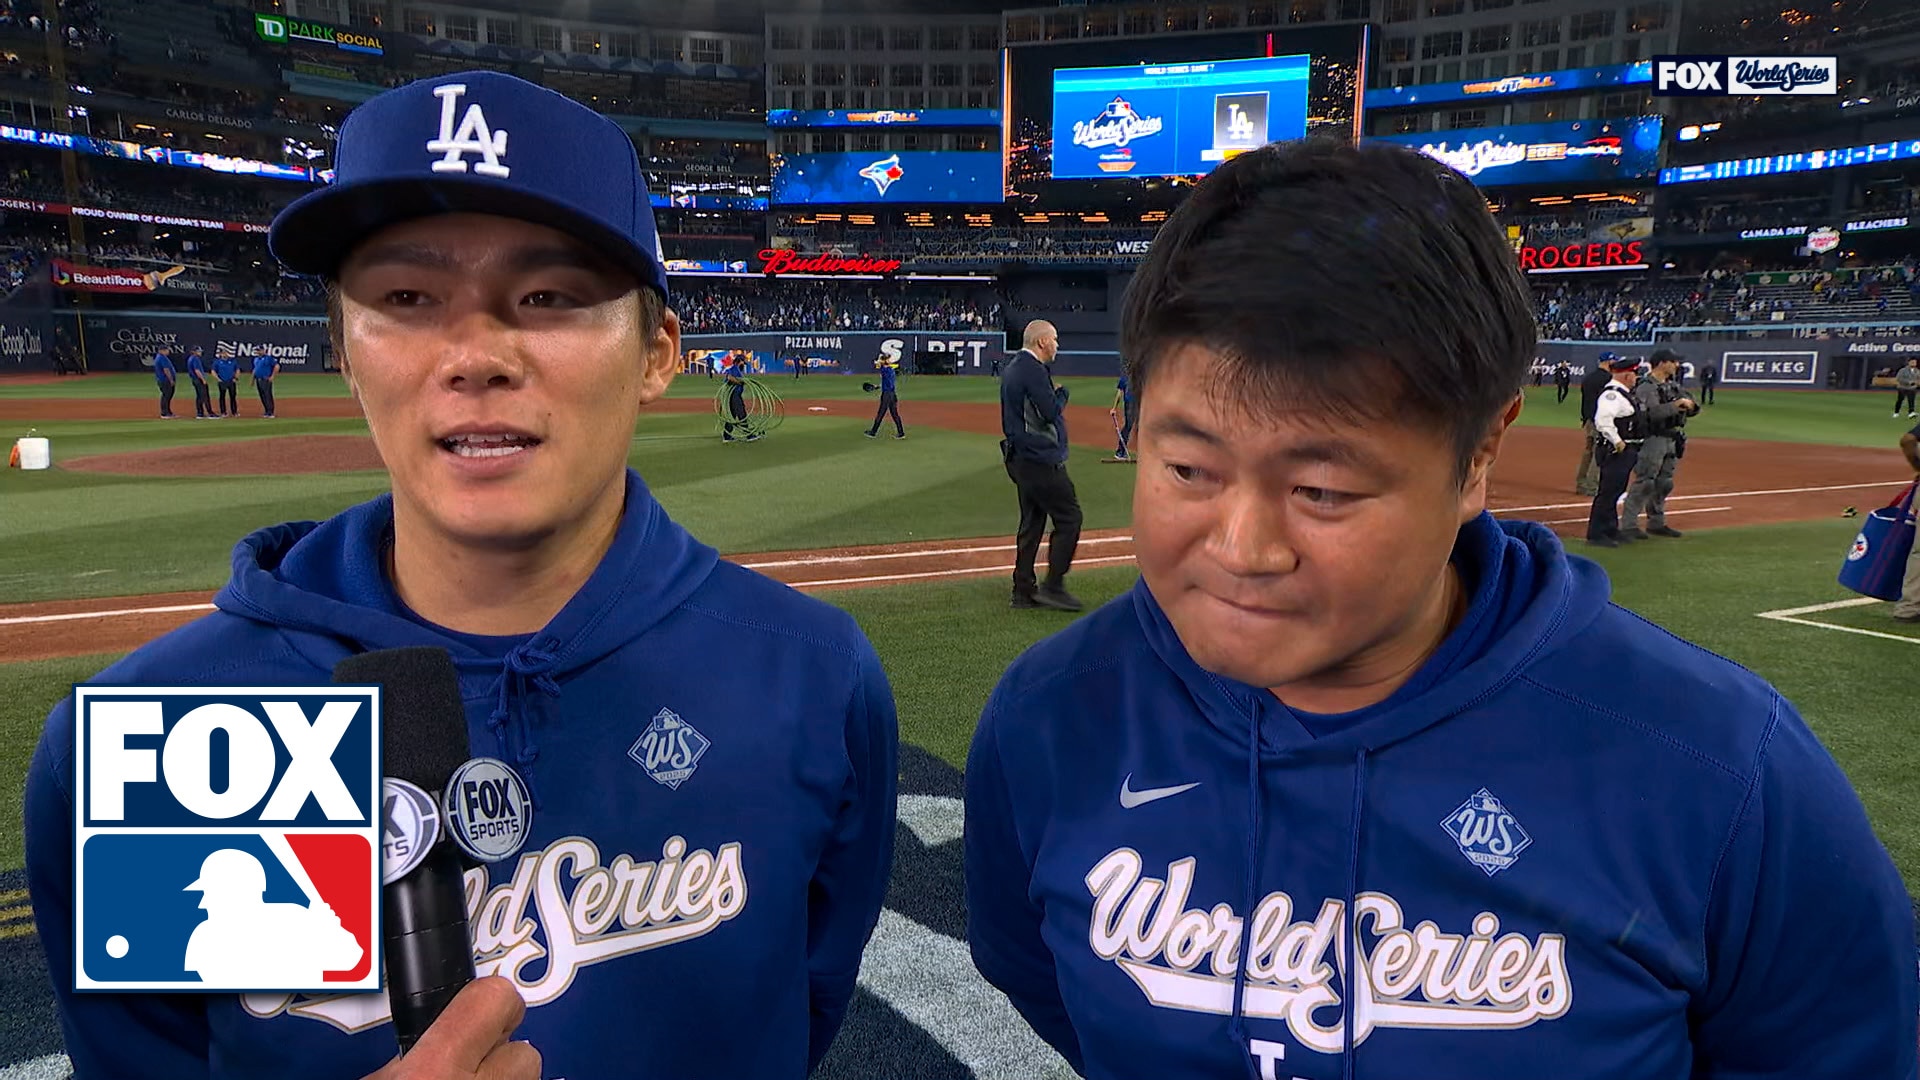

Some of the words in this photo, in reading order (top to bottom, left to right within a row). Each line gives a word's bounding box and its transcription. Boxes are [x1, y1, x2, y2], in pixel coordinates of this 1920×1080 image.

[257, 18, 284, 37] TD
[288, 21, 335, 41] PARK
[337, 32, 383, 49] SOCIAL
[1896, 95, 1920, 108] DAV
[166, 108, 204, 122] CARLOS
[207, 115, 252, 129] DELGADO
[1227, 104, 1254, 140] LA
[0, 125, 37, 141] BLUE
[39, 132, 73, 148] JAYS
[427, 84, 508, 178] LA
[1073, 117, 1124, 145] World
[1115, 115, 1163, 147] Series
[685, 164, 713, 172] GEORGE
[716, 165, 731, 173] BELL
[0, 199, 31, 210] OGERS
[71, 206, 105, 218] PROUD
[106, 210, 140, 221] OWNER
[141, 214, 154, 223] OF
[154, 216, 200, 227] CANADA'S
[200, 220, 224, 230] TEAM
[1846, 217, 1908, 232] BLEACHERS
[252, 225, 271, 233] ROG
[1740, 227, 1785, 239] CANADA
[1786, 225, 1808, 236] DRY
[1116, 240, 1153, 254] WES
[1520, 240, 1644, 270] ROGERS
[758, 249, 900, 274] Budweiser
[73, 271, 142, 288] BeautiTone
[167, 278, 196, 290] RETHINK
[0, 324, 25, 363] Google
[117, 326, 177, 344] CLEARLY
[785, 336, 814, 350] PIZZA
[815, 336, 843, 350] NOVA
[110, 340, 185, 354] CANAAN
[237, 343, 309, 357] Naional
[1848, 342, 1888, 352] Active
[279, 357, 306, 365] Rental
[1733, 361, 1765, 373] THE
[1771, 361, 1805, 373] KEG
[642, 727, 693, 770] WS
[463, 778, 517, 823] FOX
[470, 819, 520, 841] SPORTS
[1457, 808, 1514, 856] WS
[497, 836, 748, 1008] Series
[1085, 846, 1343, 985] World
[1286, 891, 1573, 1054] Series
